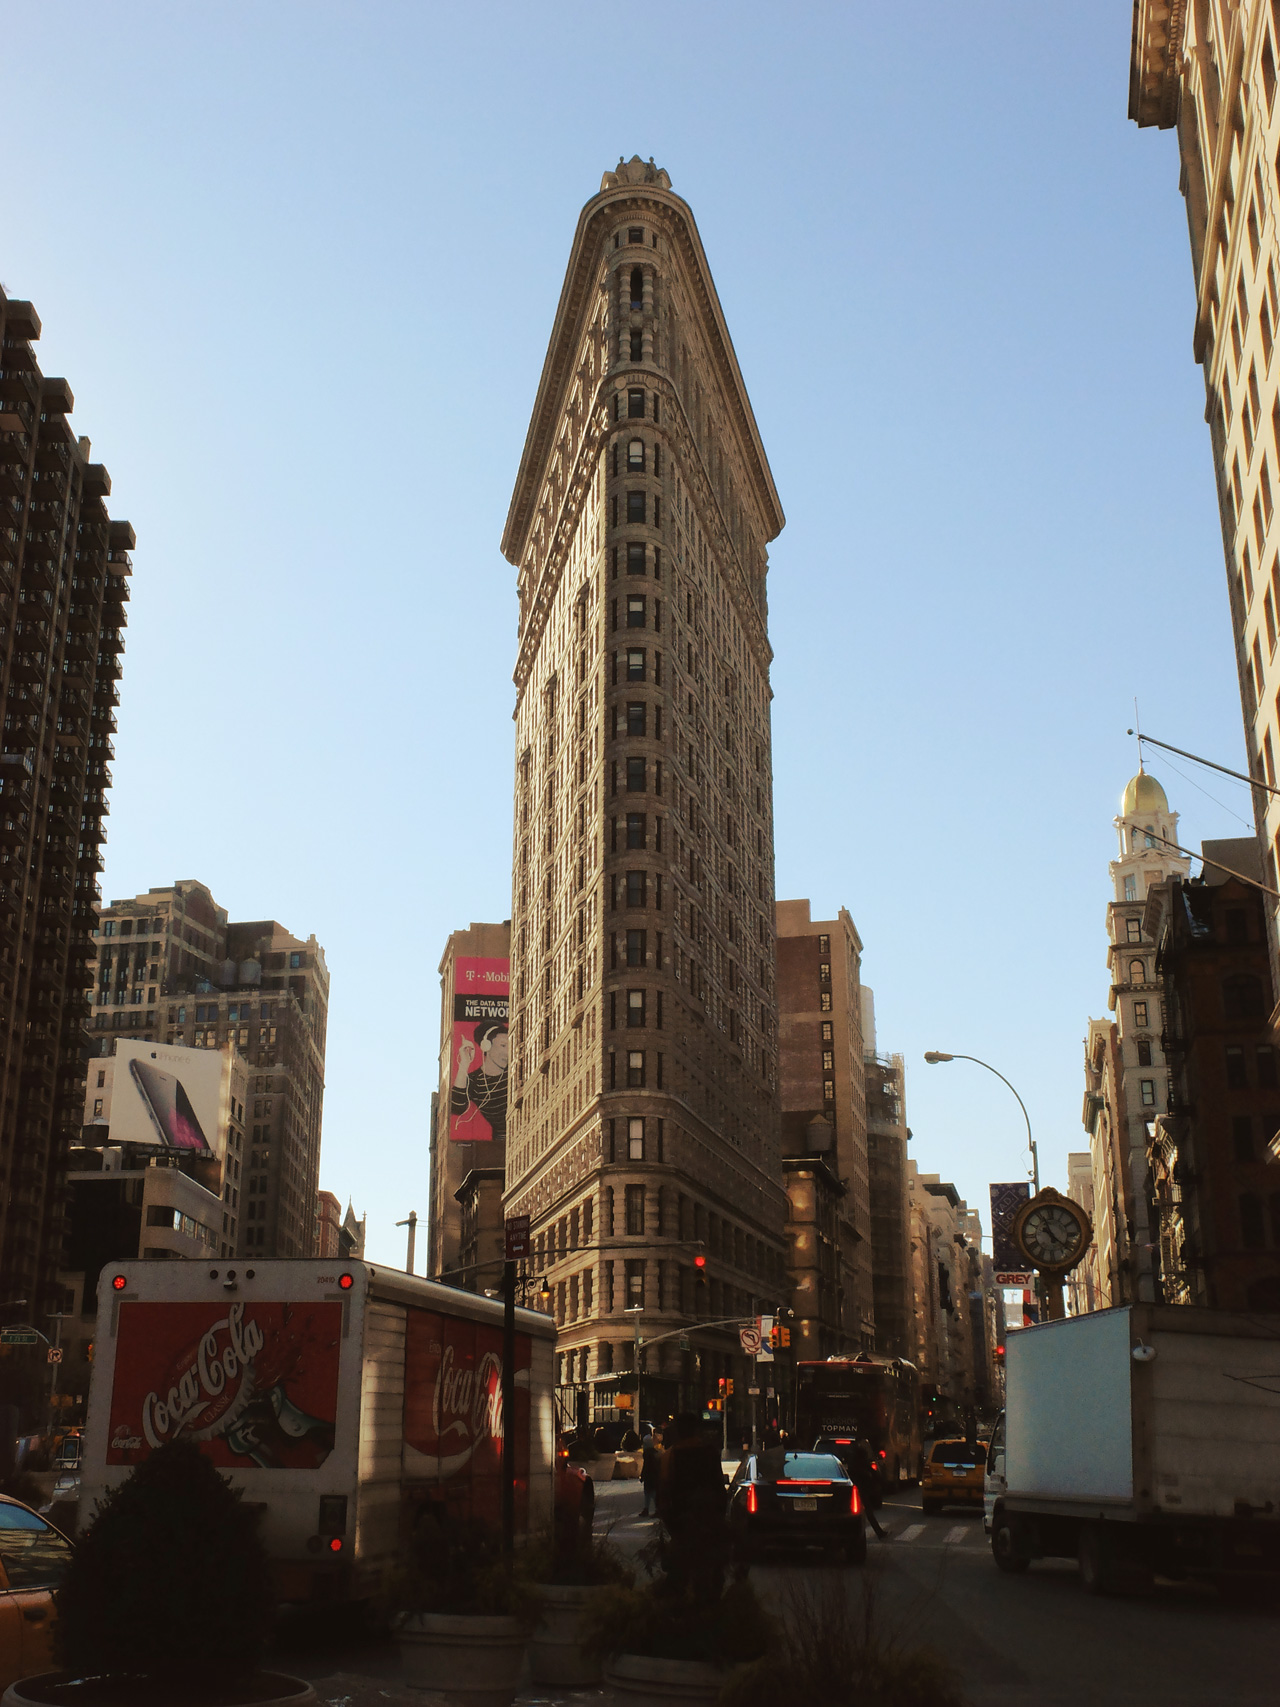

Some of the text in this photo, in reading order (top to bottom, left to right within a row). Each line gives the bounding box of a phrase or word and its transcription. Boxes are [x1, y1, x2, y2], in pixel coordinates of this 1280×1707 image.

[996, 1274, 1031, 1285] GREY
[142, 1302, 263, 1449] Coca-Cola
[204, 1391, 230, 1423] CLASSIC
